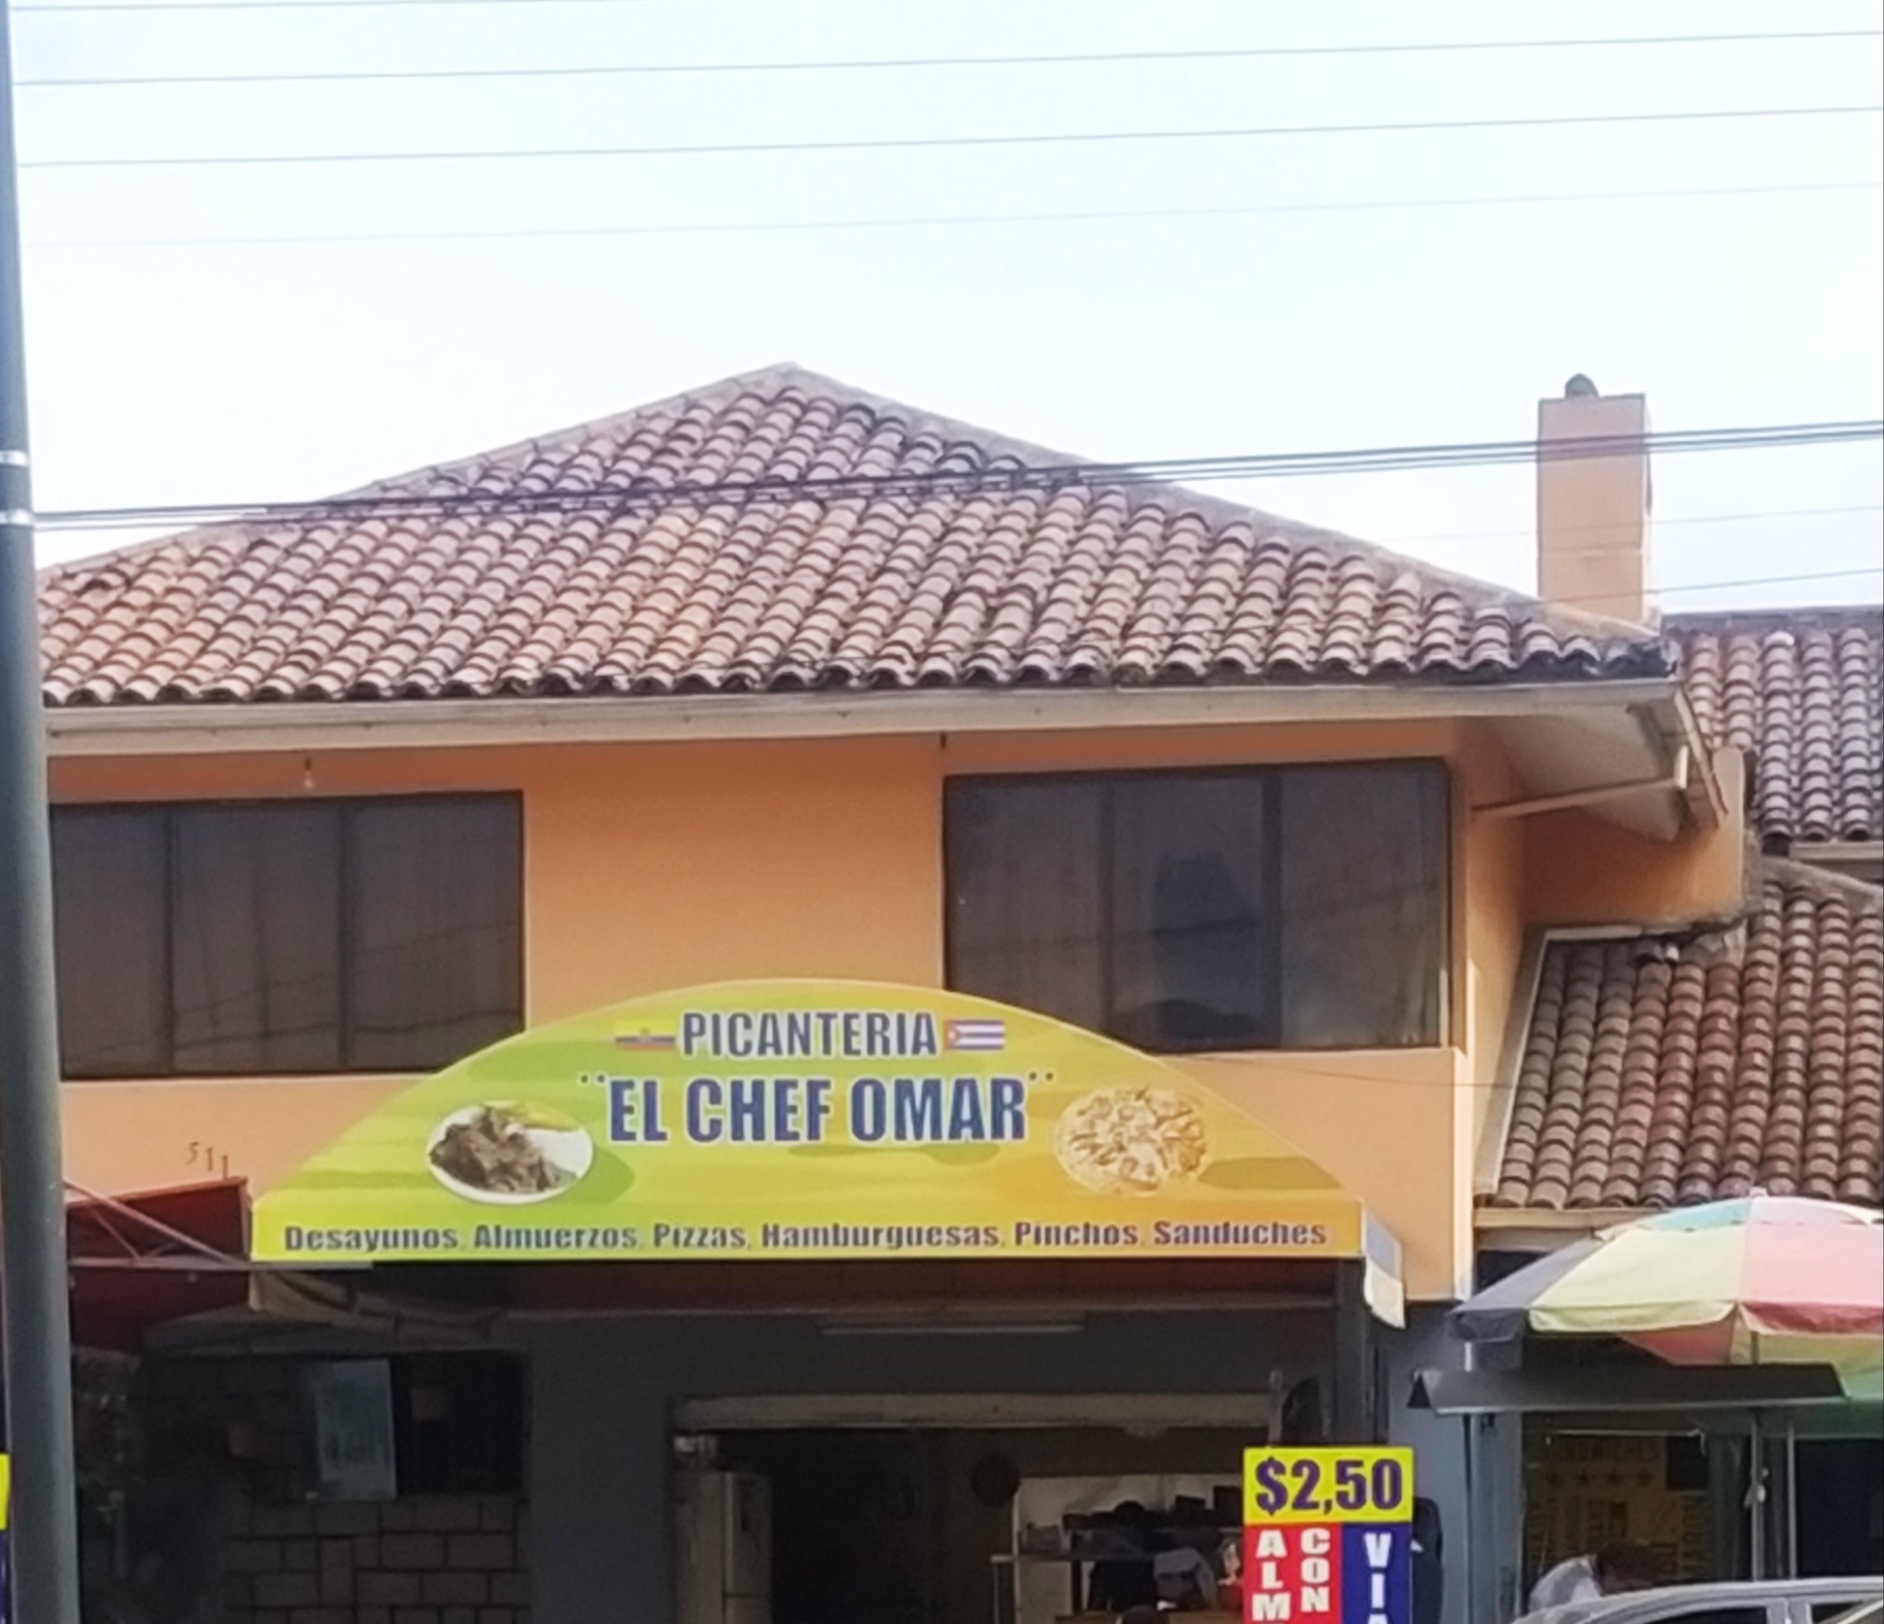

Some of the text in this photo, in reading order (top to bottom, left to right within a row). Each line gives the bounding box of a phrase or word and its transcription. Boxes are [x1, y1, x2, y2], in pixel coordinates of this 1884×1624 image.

[683, 1011, 937, 1057] PICANTERIA
[686, 1076, 831, 1142] CHEF
[1153, 1219, 1328, 1246] Sanduches
[1254, 1456, 1403, 1516] $2,50
[1300, 1527, 1331, 1613] CON
